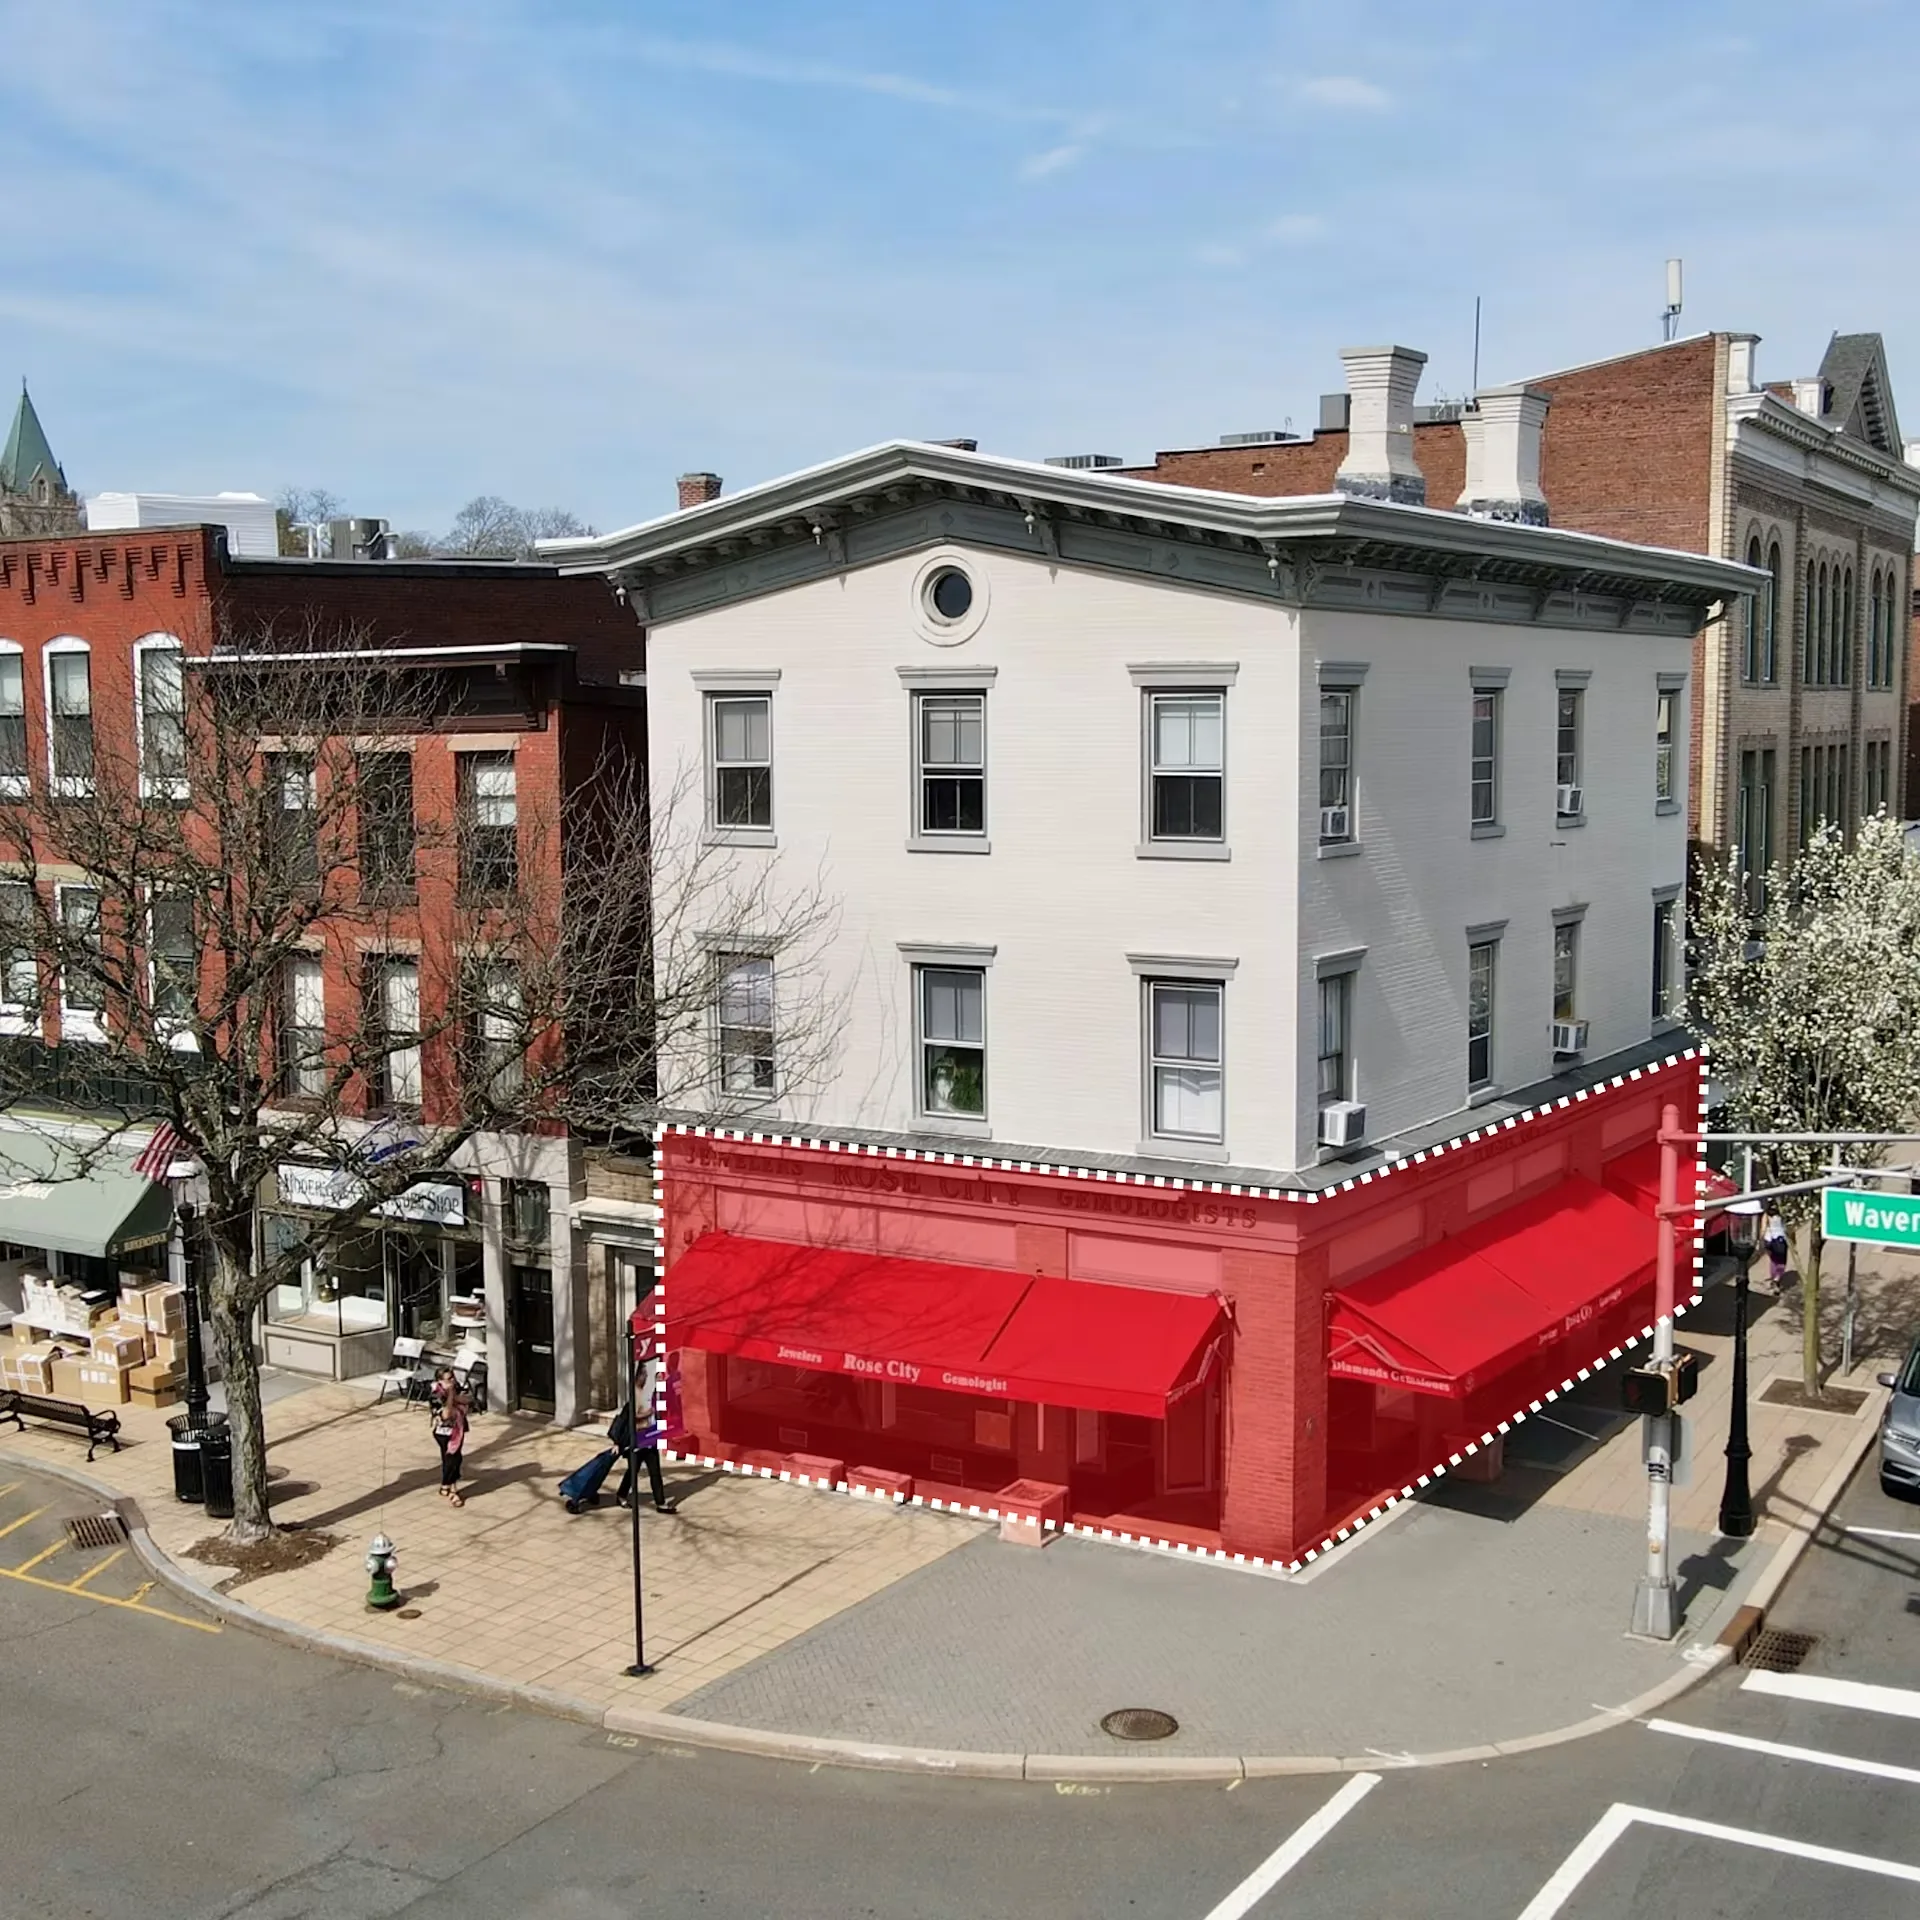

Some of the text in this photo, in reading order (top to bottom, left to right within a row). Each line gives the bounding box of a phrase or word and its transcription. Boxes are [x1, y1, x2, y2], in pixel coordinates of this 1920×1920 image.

[832, 1164, 921, 1194] ROSE
[938, 1174, 1022, 1207] CITY
[1057, 1189, 1258, 1230] GEMOLOGISTS
[777, 1346, 1007, 1393] Jewelers Rose City Gemologist
[1332, 1360, 1389, 1380] Diamonds
